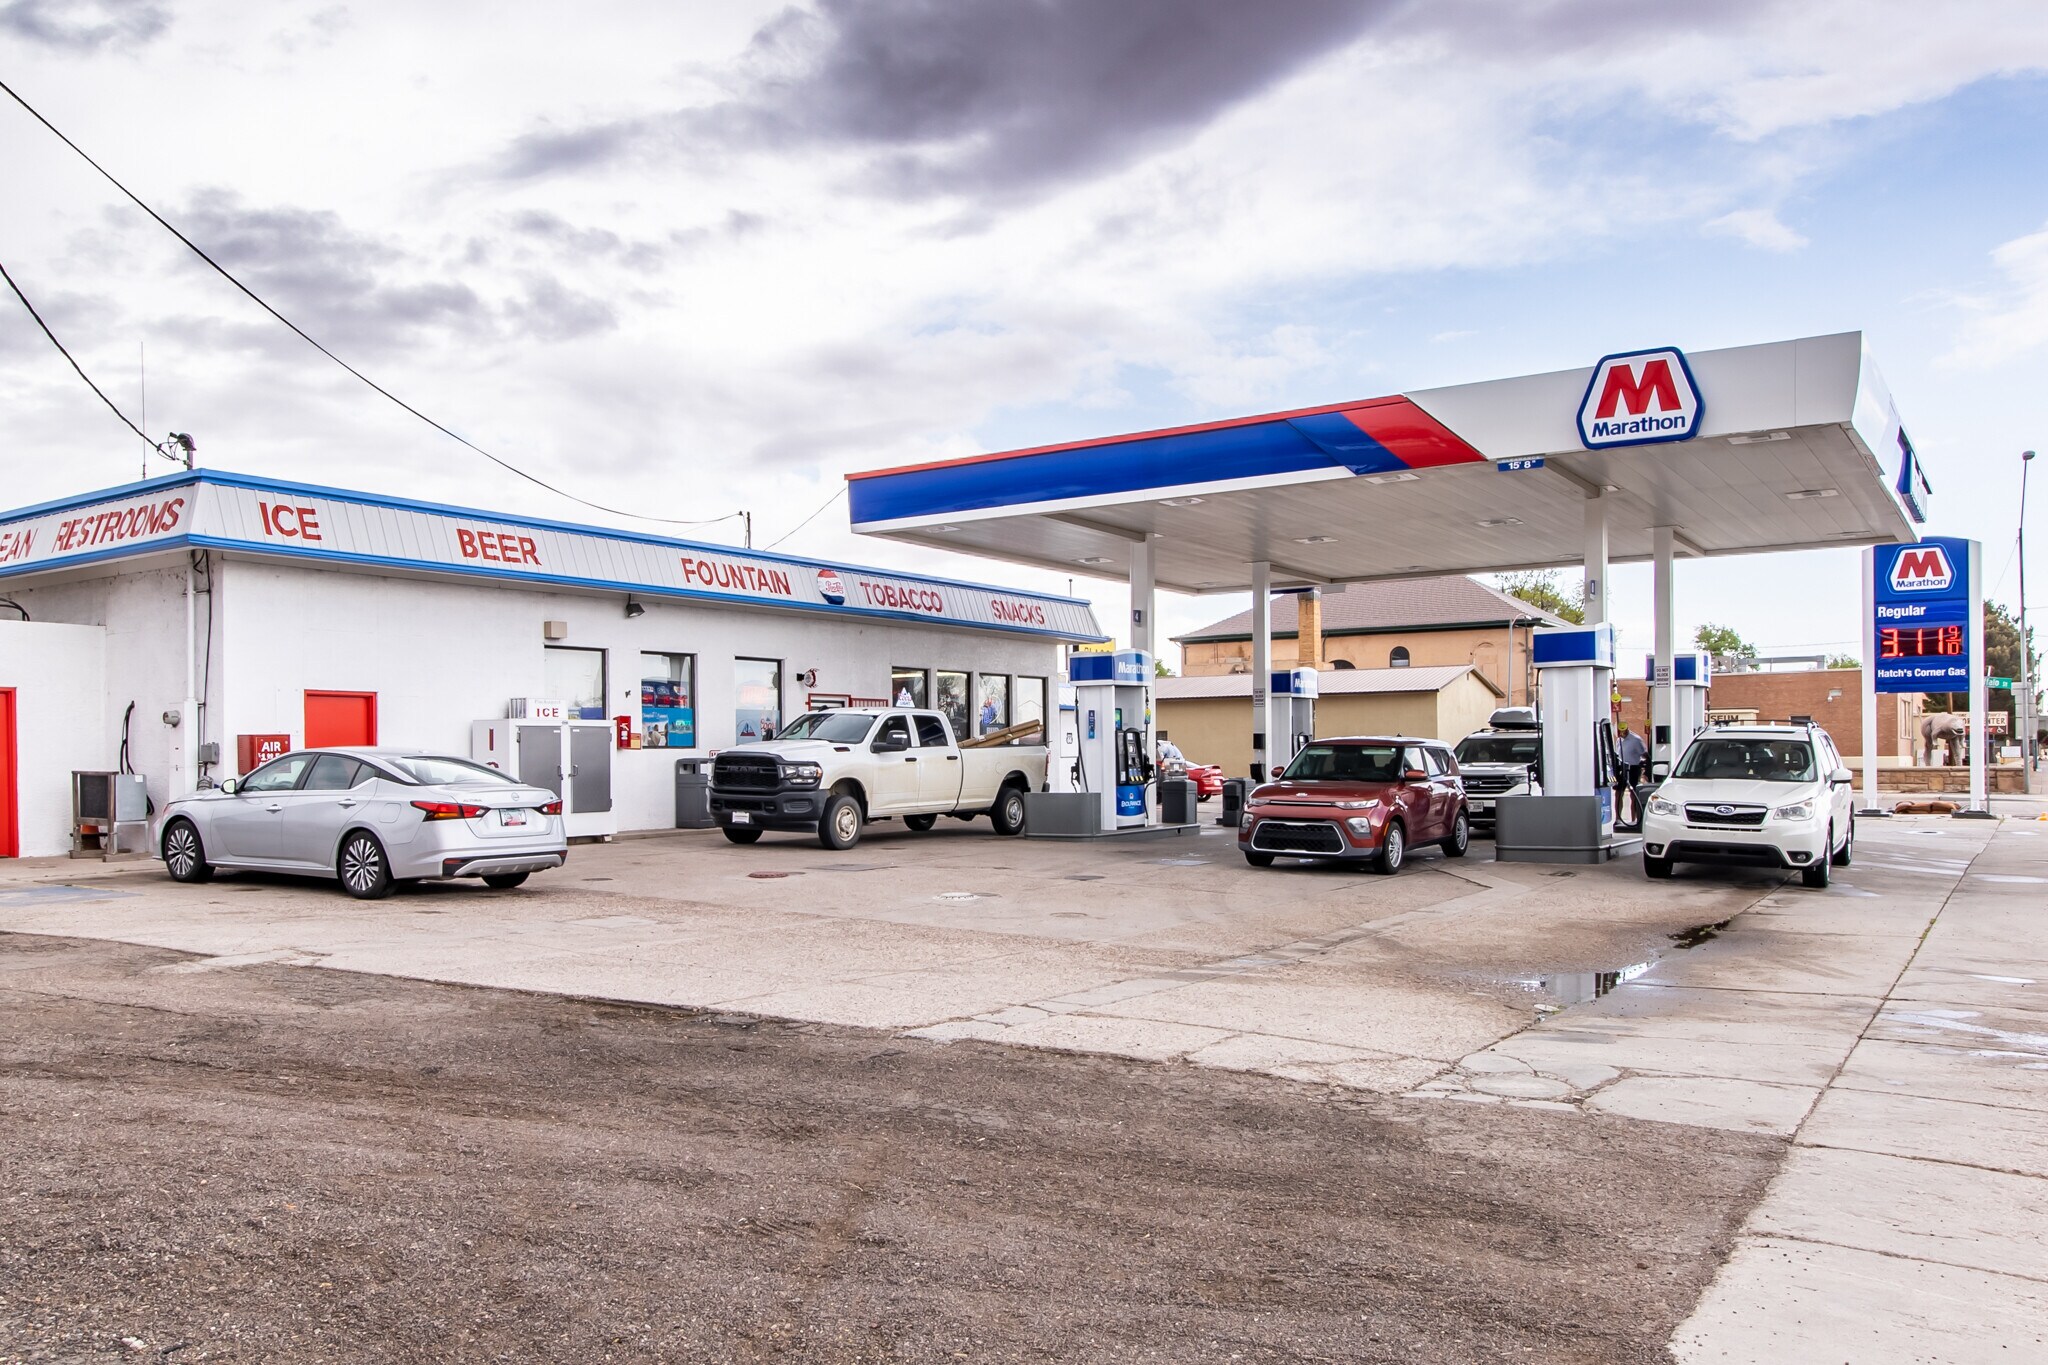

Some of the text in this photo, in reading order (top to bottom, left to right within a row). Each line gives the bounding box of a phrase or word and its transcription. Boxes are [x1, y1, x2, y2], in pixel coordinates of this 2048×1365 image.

[1595, 359, 1682, 419] M
[1591, 415, 1686, 438] Marathon
[52, 498, 184, 553] RESTROOMS
[259, 501, 322, 541] ICE
[456, 528, 542, 566] BEER
[681, 558, 791, 595] FOUNTAIN
[1897, 551, 1945, 579] M
[1895, 578, 1947, 588] Marathon
[860, 581, 943, 613] TOBACCO
[991, 599, 1045, 625] SNACKS
[1877, 605, 1926, 619] Regular
[1881, 628, 1944, 658] 3.11
[1118, 661, 1150, 674] Marathon
[1877, 667, 1966, 678] Hatch's Corner Gas
[536, 707, 559, 718] ICE
[261, 741, 281, 752] AIR
